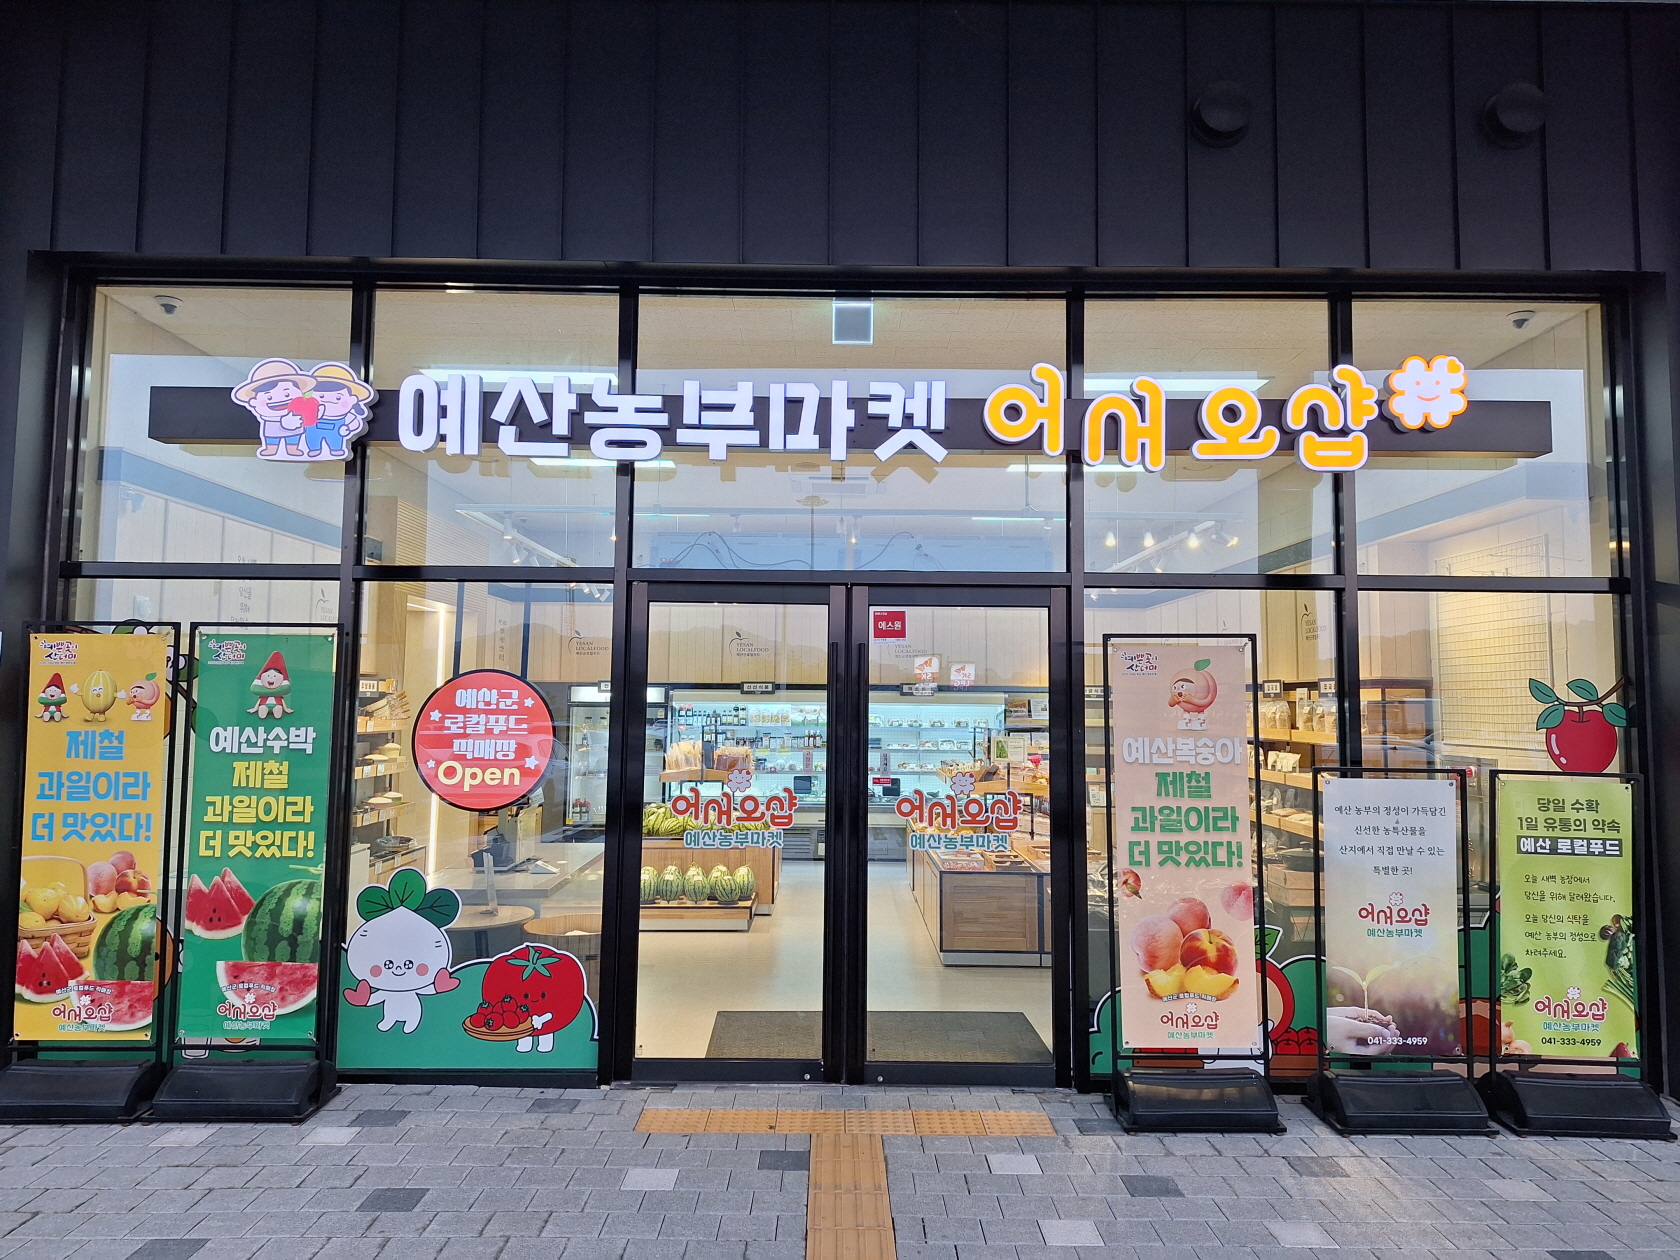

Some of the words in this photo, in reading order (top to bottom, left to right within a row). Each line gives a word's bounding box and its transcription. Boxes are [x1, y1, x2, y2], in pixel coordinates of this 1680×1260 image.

[399, 373, 950, 464] 예산농부마켓
[983, 362, 1379, 473] 어서오샵
[878, 620, 902, 631] 에스원
[455, 688, 519, 709] 예산군
[443, 713, 528, 734] 로컬푸드
[66, 729, 125, 760] 제철
[209, 726, 317, 754] 예산수박
[1122, 736, 1243, 765] 예산복숭아
[232, 760, 289, 789] 제철
[437, 760, 520, 791] Open
[36, 771, 152, 801] 과일이라
[1155, 770, 1212, 799] 제철
[203, 795, 315, 823] 과일이라
[671, 787, 798, 827] 어서오샵
[896, 789, 1023, 831] 어서오샵
[1334, 806, 1351, 816] 예산
[1354, 806, 1380, 816] 농부의
[1383, 806, 1409, 816] 정성이
[1411, 806, 1446, 817] 가득담긴
[1537, 797, 1566, 813] 당일
[1570, 798, 1600, 814] 수확
[31, 812, 55, 842] 더
[61, 812, 152, 842] 맛있다!
[1130, 805, 1240, 833] 과일이라
[1517, 816, 1539, 831] 1일
[1543, 817, 1587, 833] 유통의
[1591, 819, 1621, 834] 약속
[684, 830, 783, 848] 예산농부마켓
[1354, 826, 1380, 836] 신선한
[1382, 826, 1427, 836] 농특산물을
[198, 830, 222, 858] 더
[227, 830, 315, 858] 맛있다!
[910, 833, 1009, 851] 예산농부마켓
[1338, 845, 1374, 856] 산지에서
[1377, 846, 1394, 856] 직접
[1396, 846, 1413, 856] 만날
[1416, 846, 1426, 856] 수
[1427, 846, 1445, 856] 있는
[1519, 837, 1551, 854] 예산
[1557, 838, 1620, 855] 로컬푸드
[1127, 840, 1150, 867] 더
[1157, 840, 1244, 868] 맛있다!
[1373, 866, 1399, 875] 특별한
[1401, 866, 1413, 876] 곳!
[1524, 874, 1538, 883] 오늘
[1541, 875, 1557, 884] 새벽
[1559, 875, 1590, 885] 농장에서
[1524, 890, 1546, 901] 당신을
[1549, 891, 1566, 901] 위해
[1569, 892, 1616, 903] 달려왔습니다.
[1358, 903, 1430, 926] 어서오샵
[1524, 914, 1538, 923] 오늘
[1541, 914, 1564, 924] 당신의
[1566, 915, 1589, 925] 식탁을
[1367, 928, 1423, 938] 예산농부마켓
[1524, 931, 1542, 940] 예산
[1545, 932, 1566, 941] 농부의
[1569, 932, 1597, 942] 정성으로
[1524, 949, 1567, 958] 차려주세요.
[52, 1003, 114, 1022] 어서오샵
[217, 1000, 278, 1020] 어서오샵
[1534, 995, 1608, 1021] 어서오샵
[1160, 1010, 1220, 1029] 어서오샵
[1543, 1022, 1600, 1032] 예산농부마켓
[1167, 1031, 1214, 1039] 예산농부마켓
[1367, 1036, 1428, 1045] 041-333-4959
[1541, 1037, 1602, 1046] 041-333-4959
